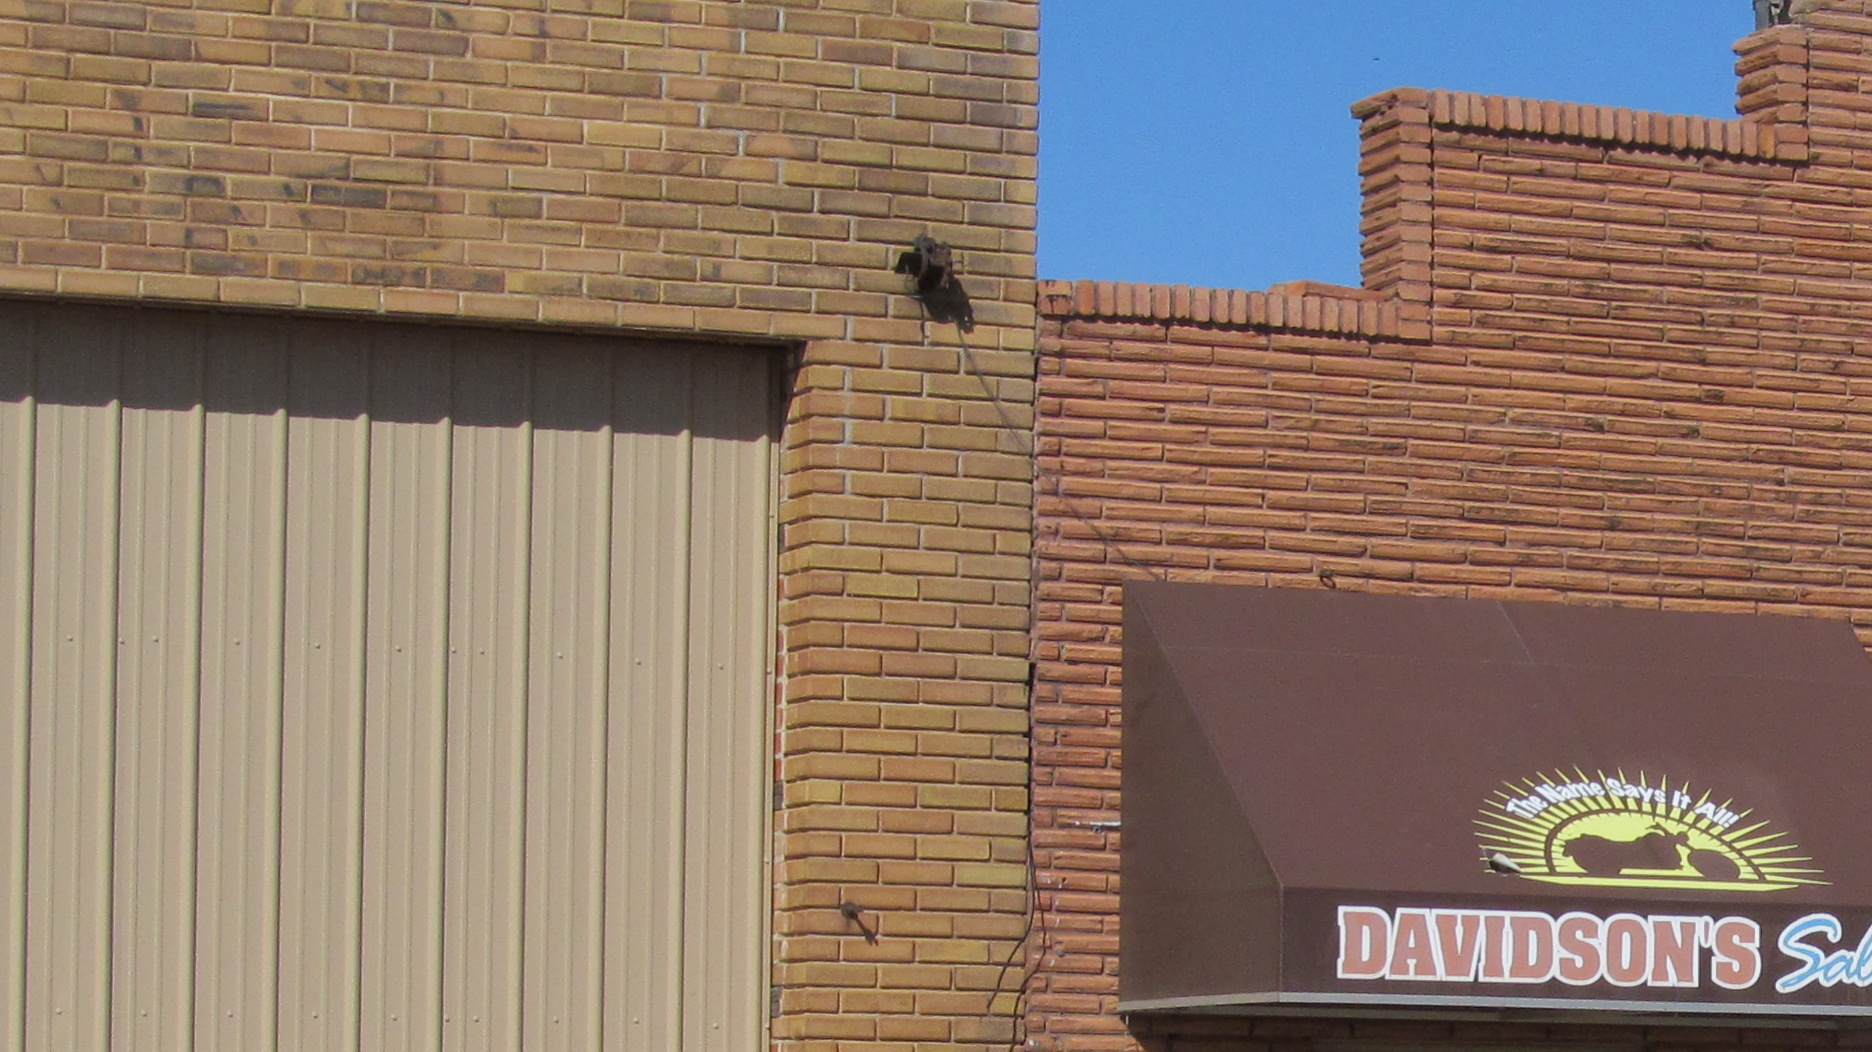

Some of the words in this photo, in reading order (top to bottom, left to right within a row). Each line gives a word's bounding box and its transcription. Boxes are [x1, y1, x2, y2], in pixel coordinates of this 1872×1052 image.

[1506, 794, 1548, 819] The
[1534, 781, 1605, 804] Name
[1606, 778, 1667, 804] Says
[1671, 790, 1692, 810] It
[1695, 801, 1740, 829] All!
[1337, 905, 1762, 990] DAVIDSON'S
